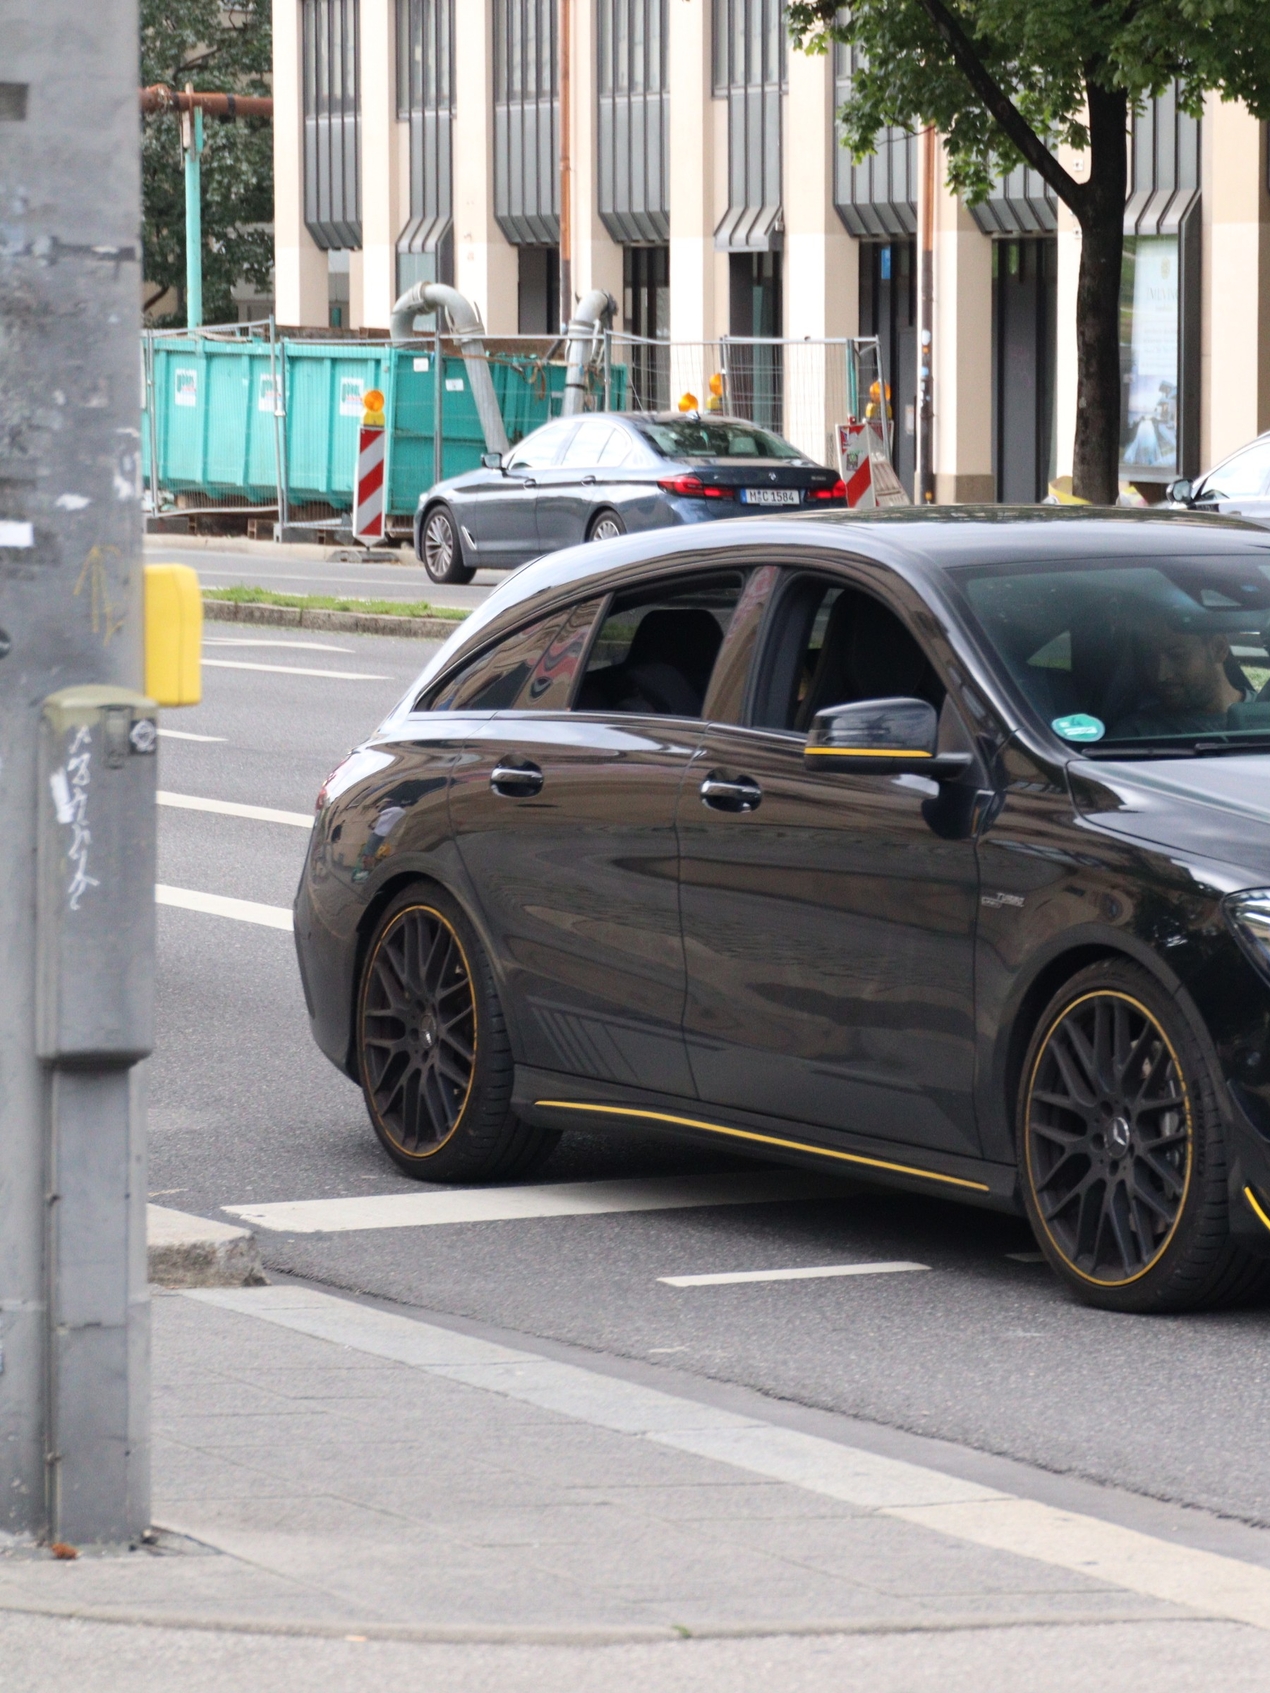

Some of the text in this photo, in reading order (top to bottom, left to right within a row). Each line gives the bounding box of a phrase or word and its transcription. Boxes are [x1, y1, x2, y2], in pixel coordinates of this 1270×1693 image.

[749, 490, 795, 502] M C 1584
